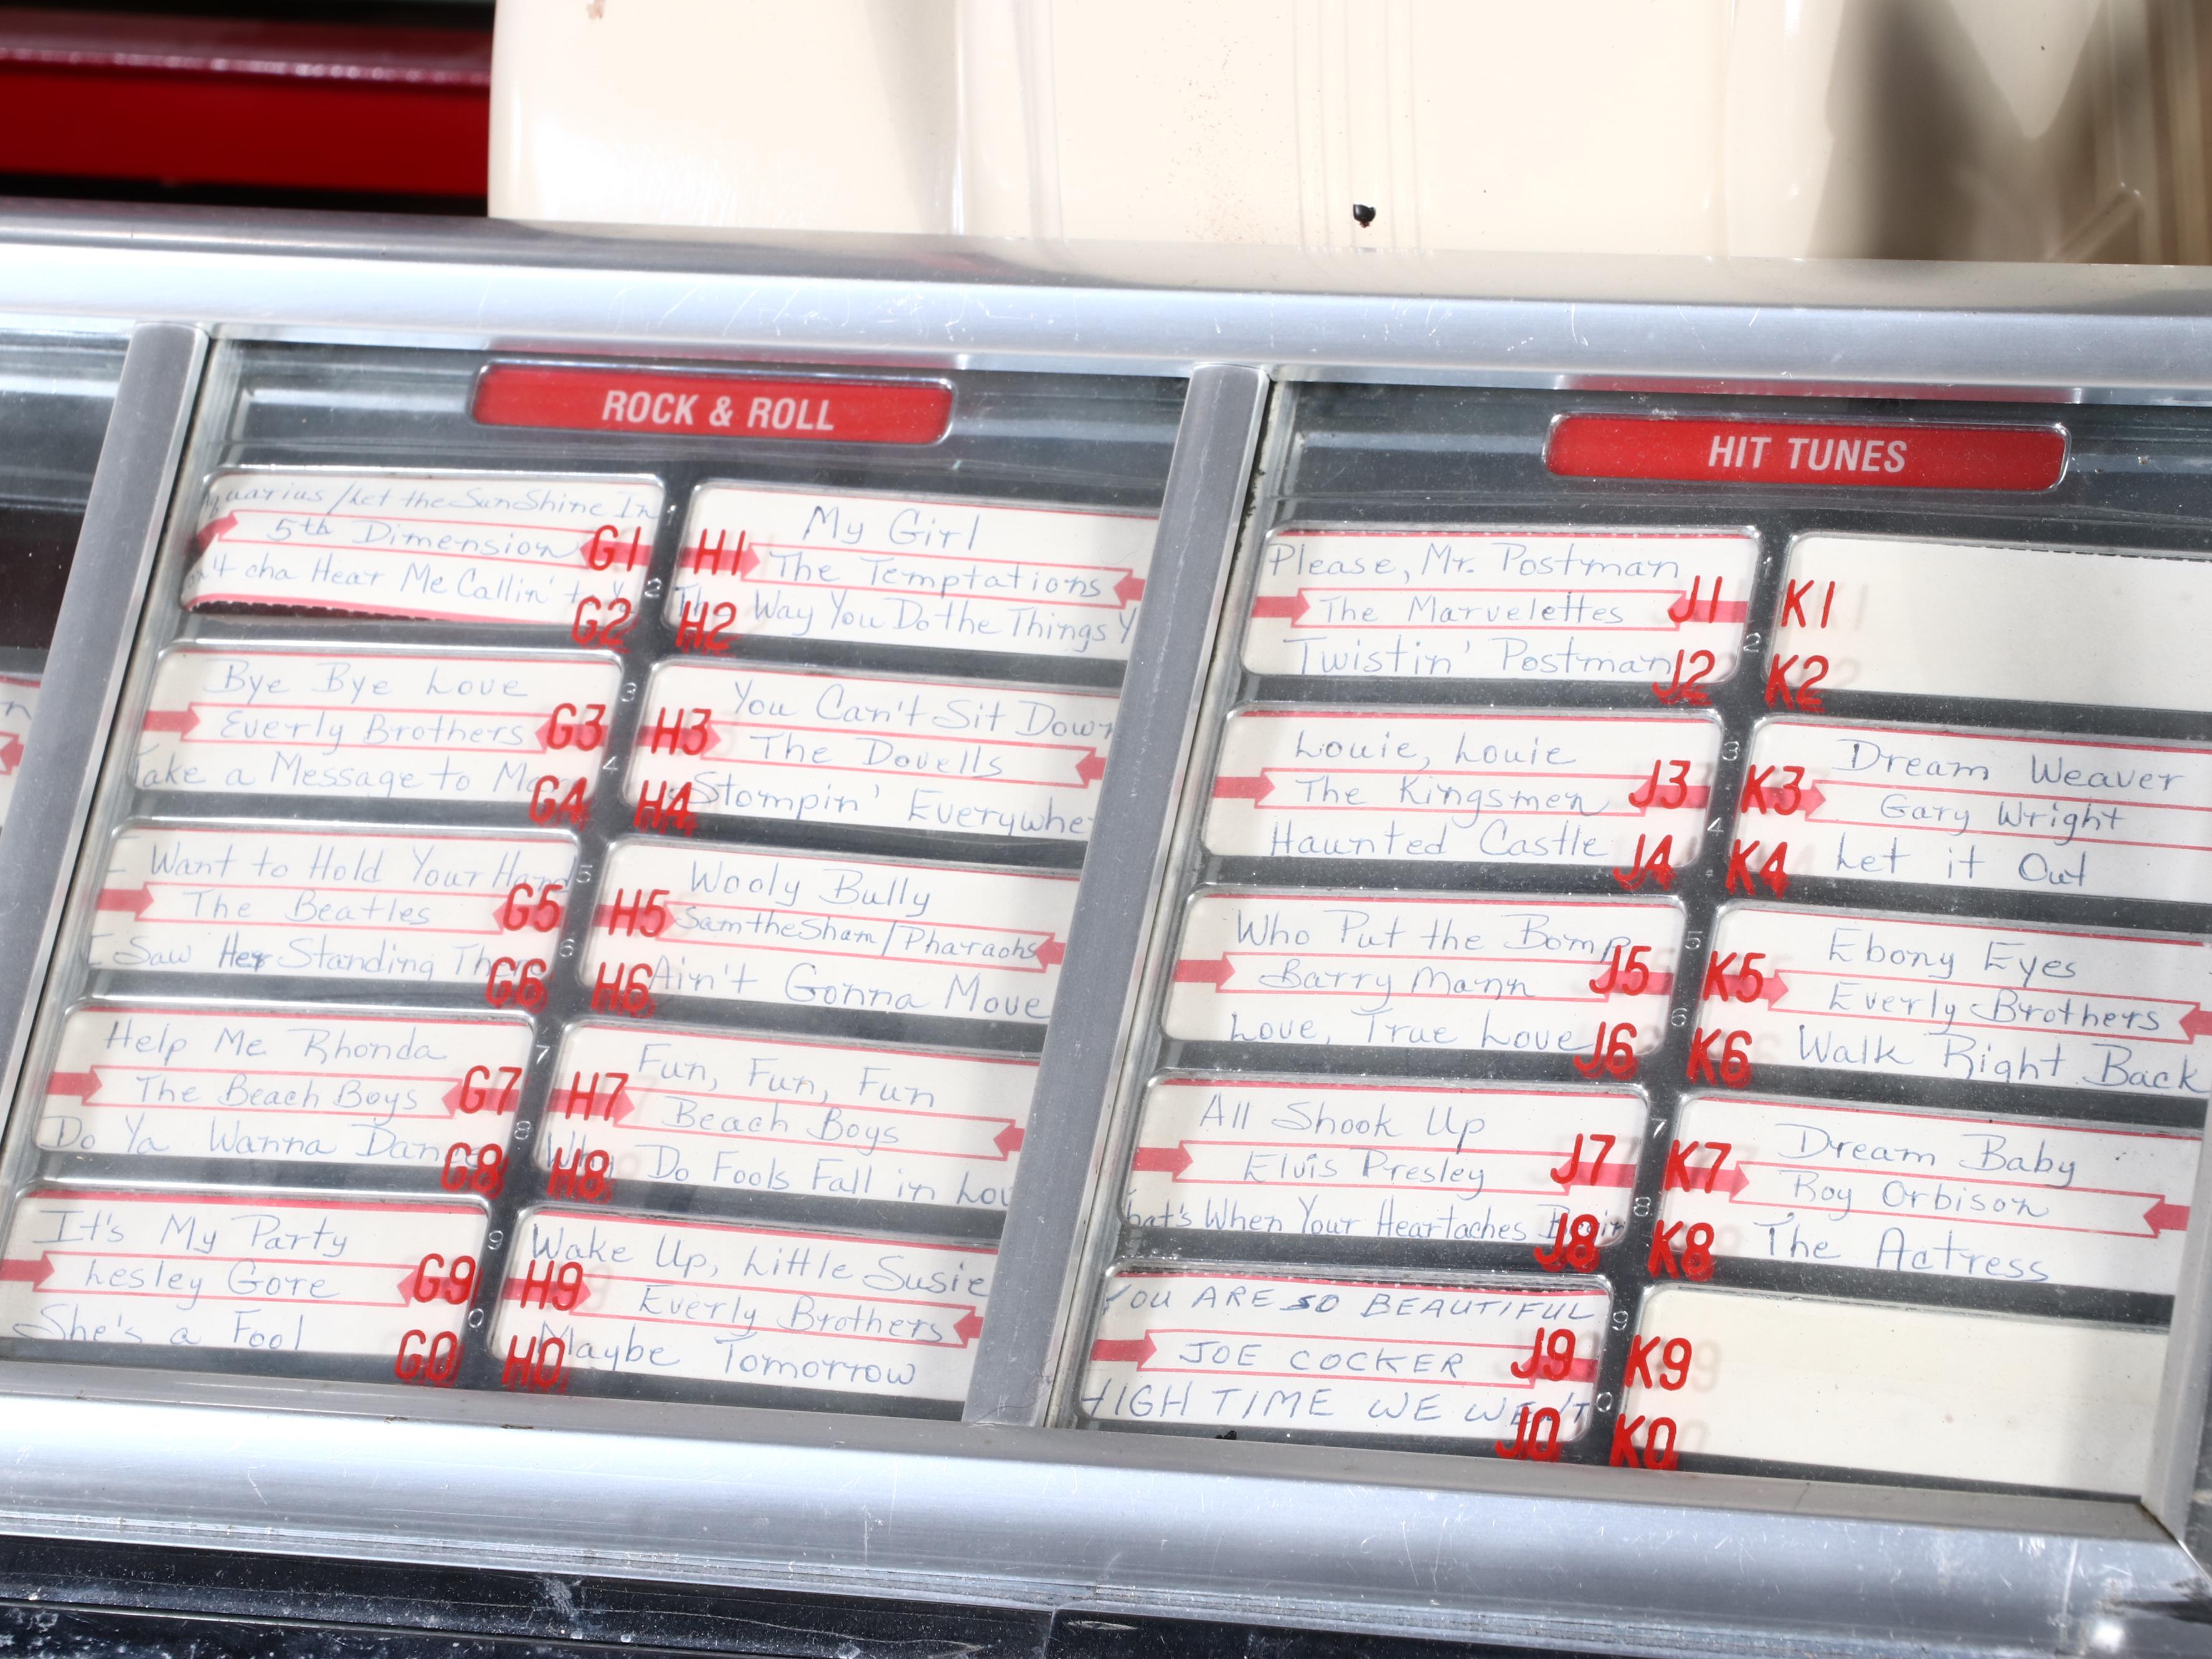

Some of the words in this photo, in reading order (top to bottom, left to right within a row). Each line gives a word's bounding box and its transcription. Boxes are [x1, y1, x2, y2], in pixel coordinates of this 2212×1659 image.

[602, 390, 700, 425] ROCK
[709, 397, 732, 427] &
[747, 397, 836, 430] ROLL
[1708, 435, 1772, 469] HIT
[1789, 437, 1907, 473] TUNES
[267, 518, 334, 542] 5th
[353, 520, 580, 559] Dimension
[589, 525, 642, 572] G1
[693, 527, 745, 576] H1
[803, 506, 864, 545] My
[889, 508, 981, 551] Girl
[245, 555, 298, 584] cha
[400, 562, 443, 595] Me
[770, 551, 841, 583] The
[864, 556, 1103, 600] Temptations
[1267, 542, 1411, 584] Please,
[1421, 541, 1475, 575] Mr.
[1491, 541, 1680, 579] Postman
[570, 597, 632, 644] G2
[753, 590, 813, 636] Way
[1008, 606, 1108, 653] Things
[1320, 596, 1379, 623] The
[1407, 592, 1625, 625] Marvelettes
[1668, 575, 1722, 624] J1
[1780, 579, 1836, 629] K1
[674, 601, 737, 650] H2
[1487, 635, 1674, 676] Postman
[1652, 649, 1715, 704] J2
[204, 659, 290, 703] Bye
[312, 661, 393, 704] Bye
[427, 668, 529, 697] Love
[735, 679, 798, 718] You
[816, 684, 927, 728] Can't
[934, 698, 1008, 730] Sit
[1765, 653, 1830, 712] K2
[220, 709, 343, 755] Everly
[364, 714, 524, 745] Brothers
[546, 703, 606, 751] G3
[651, 707, 712, 757] H3
[751, 732, 834, 763] The
[1295, 730, 1432, 772] Louie,
[1455, 732, 1577, 766] Louie
[225, 767, 255, 786] a
[271, 752, 424, 796] Message
[430, 759, 471, 790] to
[1628, 759, 1691, 810] J3
[1741, 763, 1805, 816] K3
[1832, 739, 1988, 781] Dream
[2030, 754, 2186, 792] Weaver
[529, 775, 587, 824] G4
[633, 780, 693, 829] H4
[1295, 778, 1361, 808] The
[1401, 774, 1609, 830] Kingsmen
[1880, 793, 1969, 836] Gary
[1997, 801, 2126, 846] Wright
[1270, 817, 1447, 858] Haunted
[1480, 821, 1609, 859] Castle
[1613, 833, 1673, 886] J4
[151, 844, 239, 876] Want
[249, 847, 289, 879] to
[310, 847, 383, 884] Hold
[413, 847, 481, 886] Your
[691, 861, 800, 908] Wooly
[819, 869, 931, 911] Bully
[1725, 838, 1789, 897] K4
[1947, 845, 1985, 879] it
[2018, 851, 2088, 887] Out
[186, 891, 252, 918] The
[286, 889, 430, 924] Beatles
[503, 883, 563, 933] G5
[609, 888, 670, 938] H5
[1237, 910, 1310, 947] Who
[1323, 909, 1407, 950] Put
[1419, 914, 1483, 952] the
[113, 940, 191, 967] Saw
[1589, 945, 1652, 996] J5
[1703, 951, 1765, 1003] K5
[1828, 925, 1956, 980] Ebony
[1983, 940, 2077, 989] Eyes
[486, 957, 547, 1008] G6
[592, 962, 653, 1013] H6
[785, 963, 933, 1010] Gonna
[944, 972, 1052, 1021] Move
[1258, 958, 1392, 1014] Barry
[1412, 966, 1536, 1000] Mann
[1229, 1013, 1330, 1046] Love,
[1351, 1006, 1458, 1045] True
[1828, 980, 1957, 1037] Everly
[1972, 989, 2160, 1031] Brothers
[105, 1020, 187, 1066] Help
[214, 1029, 267, 1056] Me
[1573, 1021, 1638, 1075] J6
[1686, 1026, 1753, 1088] K6
[1798, 1024, 1915, 1066] Walk
[2082, 1042, 2212, 1094] Back
[136, 1075, 202, 1104] The
[220, 1074, 320, 1109] Beach
[334, 1078, 417, 1127] Boys
[458, 1065, 522, 1116] G7
[565, 1071, 629, 1121] H7
[639, 1042, 718, 1092] Fun,
[749, 1059, 828, 1104] Fun,
[859, 1067, 934, 1109] Fun
[210, 1117, 336, 1156] Wanna
[664, 1095, 789, 1135] Beach
[809, 1108, 899, 1156] Boys
[1199, 1093, 1249, 1130] All
[1271, 1100, 1401, 1137] Shook
[1427, 1106, 1487, 1154] Up
[440, 1142, 502, 1191] G8
[547, 1147, 610, 1199] H8
[635, 1144, 689, 1182] Do
[712, 1151, 790, 1192] Fools
[811, 1158, 872, 1196] Fall
[1245, 1150, 1339, 1181] Elvis
[1350, 1146, 1485, 1201] Presley
[1549, 1133, 1617, 1186] J7
[1663, 1139, 1732, 1194] K7
[1774, 1123, 1936, 1168] Dream
[1959, 1133, 2079, 1189] Baby
[1205, 1198, 1282, 1232] When
[1298, 1195, 1357, 1235] Your
[1378, 1196, 1527, 1240] Heartaches
[1777, 1169, 1854, 1222] Roy
[1882, 1179, 2049, 1219] Orbison
[32, 1209, 125, 1244] It's
[161, 1214, 217, 1254] My
[231, 1214, 348, 1256] Party
[1534, 1212, 1597, 1269] J8
[1647, 1219, 1715, 1280] K8
[1753, 1211, 1842, 1262] The
[1874, 1227, 2051, 1283] Actress
[228, 1259, 341, 1299] Gore
[412, 1252, 476, 1304] G9
[532, 1222, 634, 1264] Wake
[655, 1233, 719, 1280] Up,
[744, 1247, 853, 1280] Little
[862, 1255, 990, 1297] Susie
[521, 1259, 584, 1311] H9
[1190, 1287, 1278, 1308] ARE
[1360, 1292, 1595, 1321] BEAUTIFUL
[13, 1303, 144, 1343] She's
[169, 1326, 201, 1346] a
[232, 1310, 305, 1351] Fool
[777, 1295, 943, 1342] Brothers
[713, 1331, 917, 1386] Tomorrow
[1178, 1340, 1263, 1366] JOE
[1289, 1349, 1464, 1379] COCKER
[1510, 1326, 1577, 1381] J9
[1624, 1334, 1692, 1391] K9
[1212, 1387, 1335, 1419] TIME
[1368, 1396, 1442, 1422] WE
